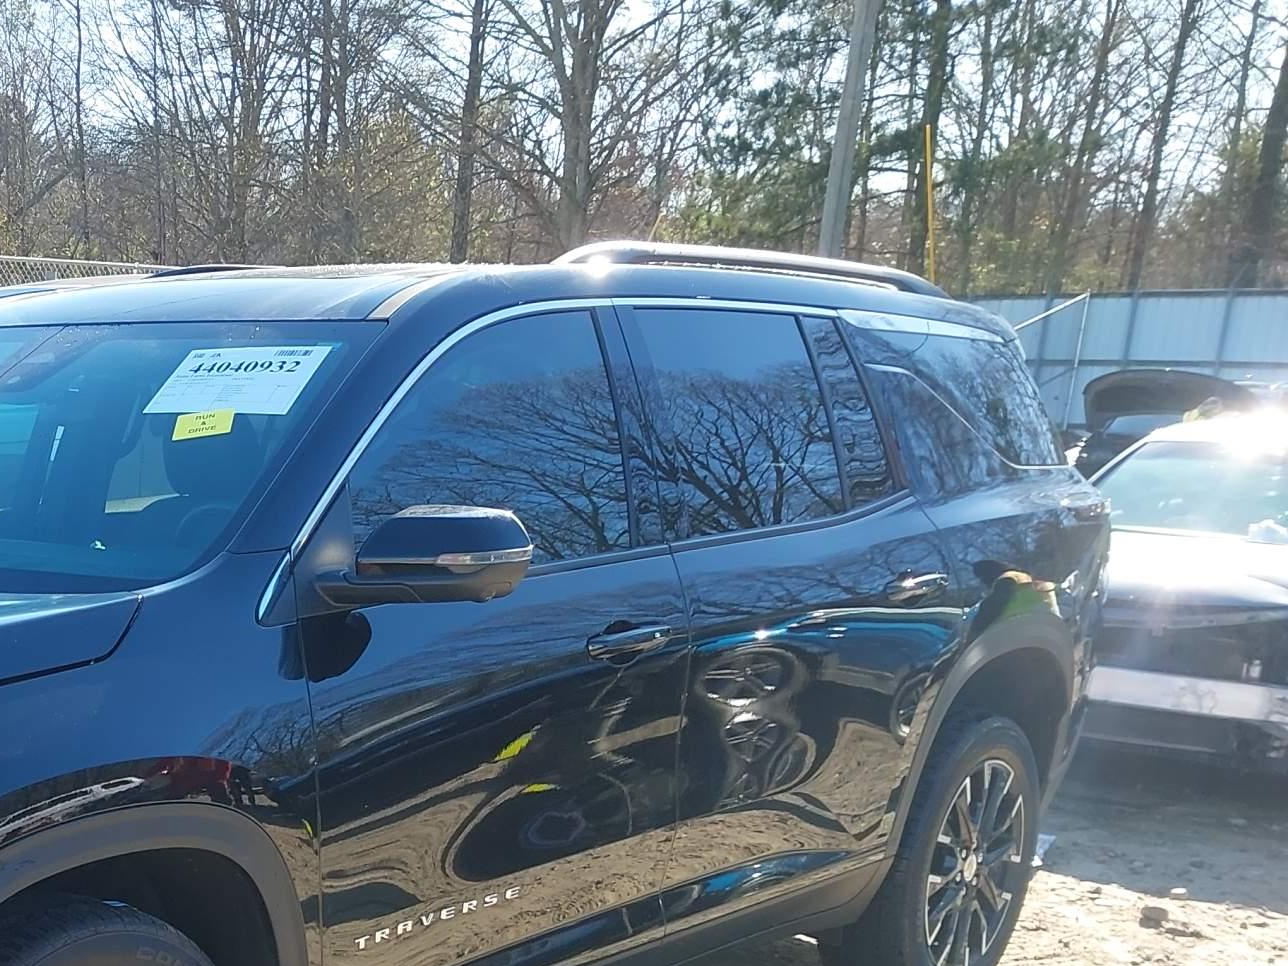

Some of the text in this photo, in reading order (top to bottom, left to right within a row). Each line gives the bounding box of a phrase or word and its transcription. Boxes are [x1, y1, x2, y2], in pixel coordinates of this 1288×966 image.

[189, 359, 301, 374] 44040932
[195, 413, 216, 421] RUN
[187, 425, 217, 434] DRIVE
[354, 886, 521, 950] TRAVERSE
